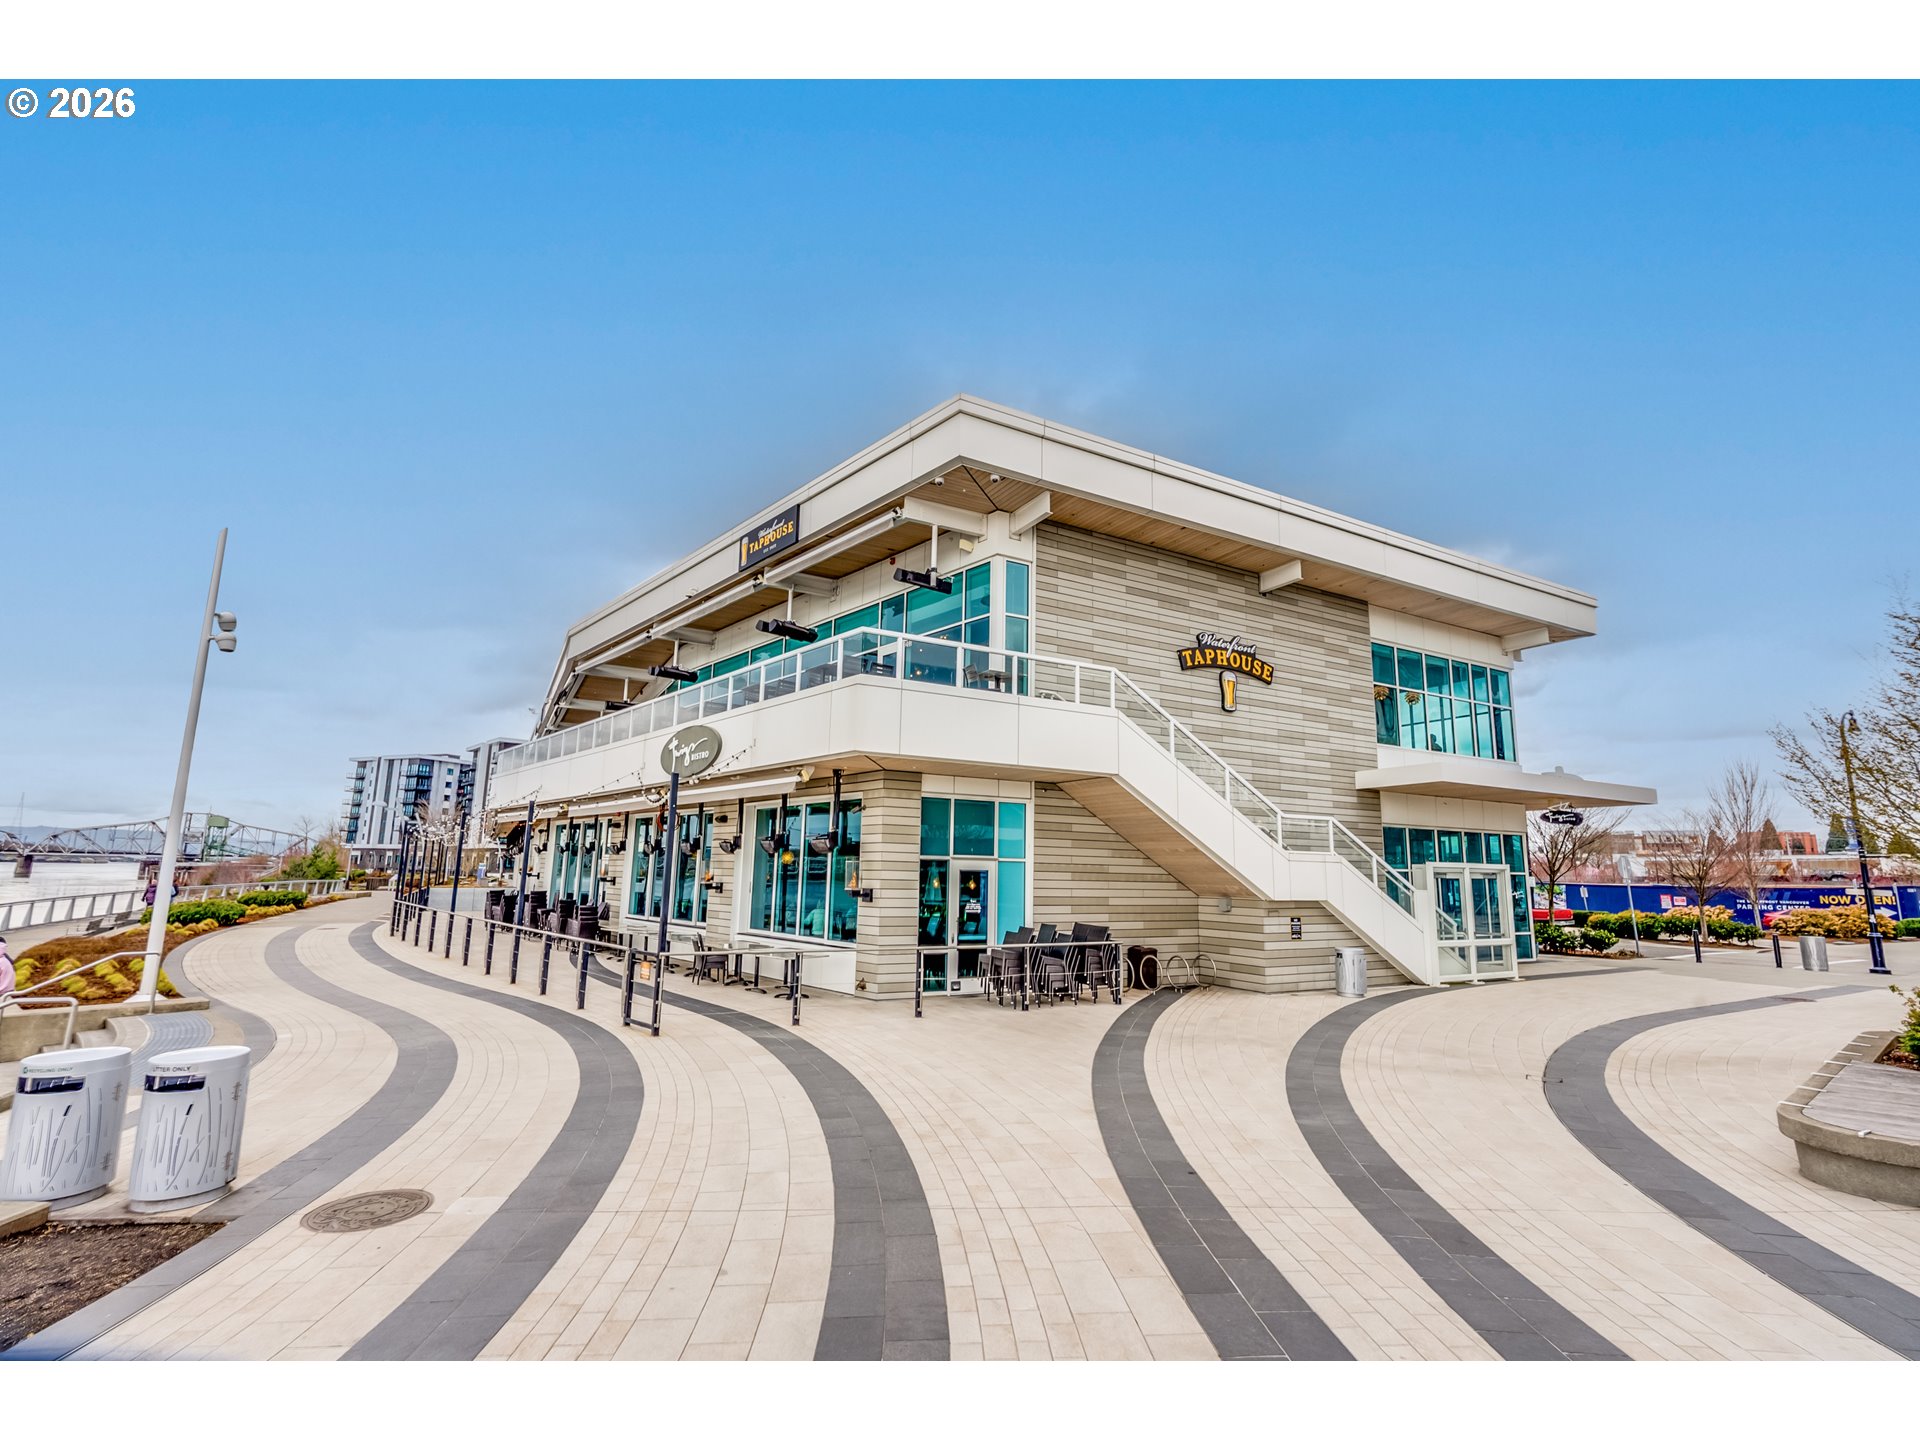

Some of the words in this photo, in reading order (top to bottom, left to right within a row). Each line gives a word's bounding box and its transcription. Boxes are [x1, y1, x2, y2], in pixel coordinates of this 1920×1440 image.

[749, 521, 794, 554] TAPHOUSE
[1199, 632, 1257, 658] Waterfront
[1182, 649, 1273, 682] TAPHOUSE
[691, 750, 710, 761] BISTRO
[1819, 895, 1851, 905] NOW
[1855, 896, 1897, 906] OEN!
[1736, 903, 1774, 911] PARING
[172, 1065, 192, 1073] ONLY
